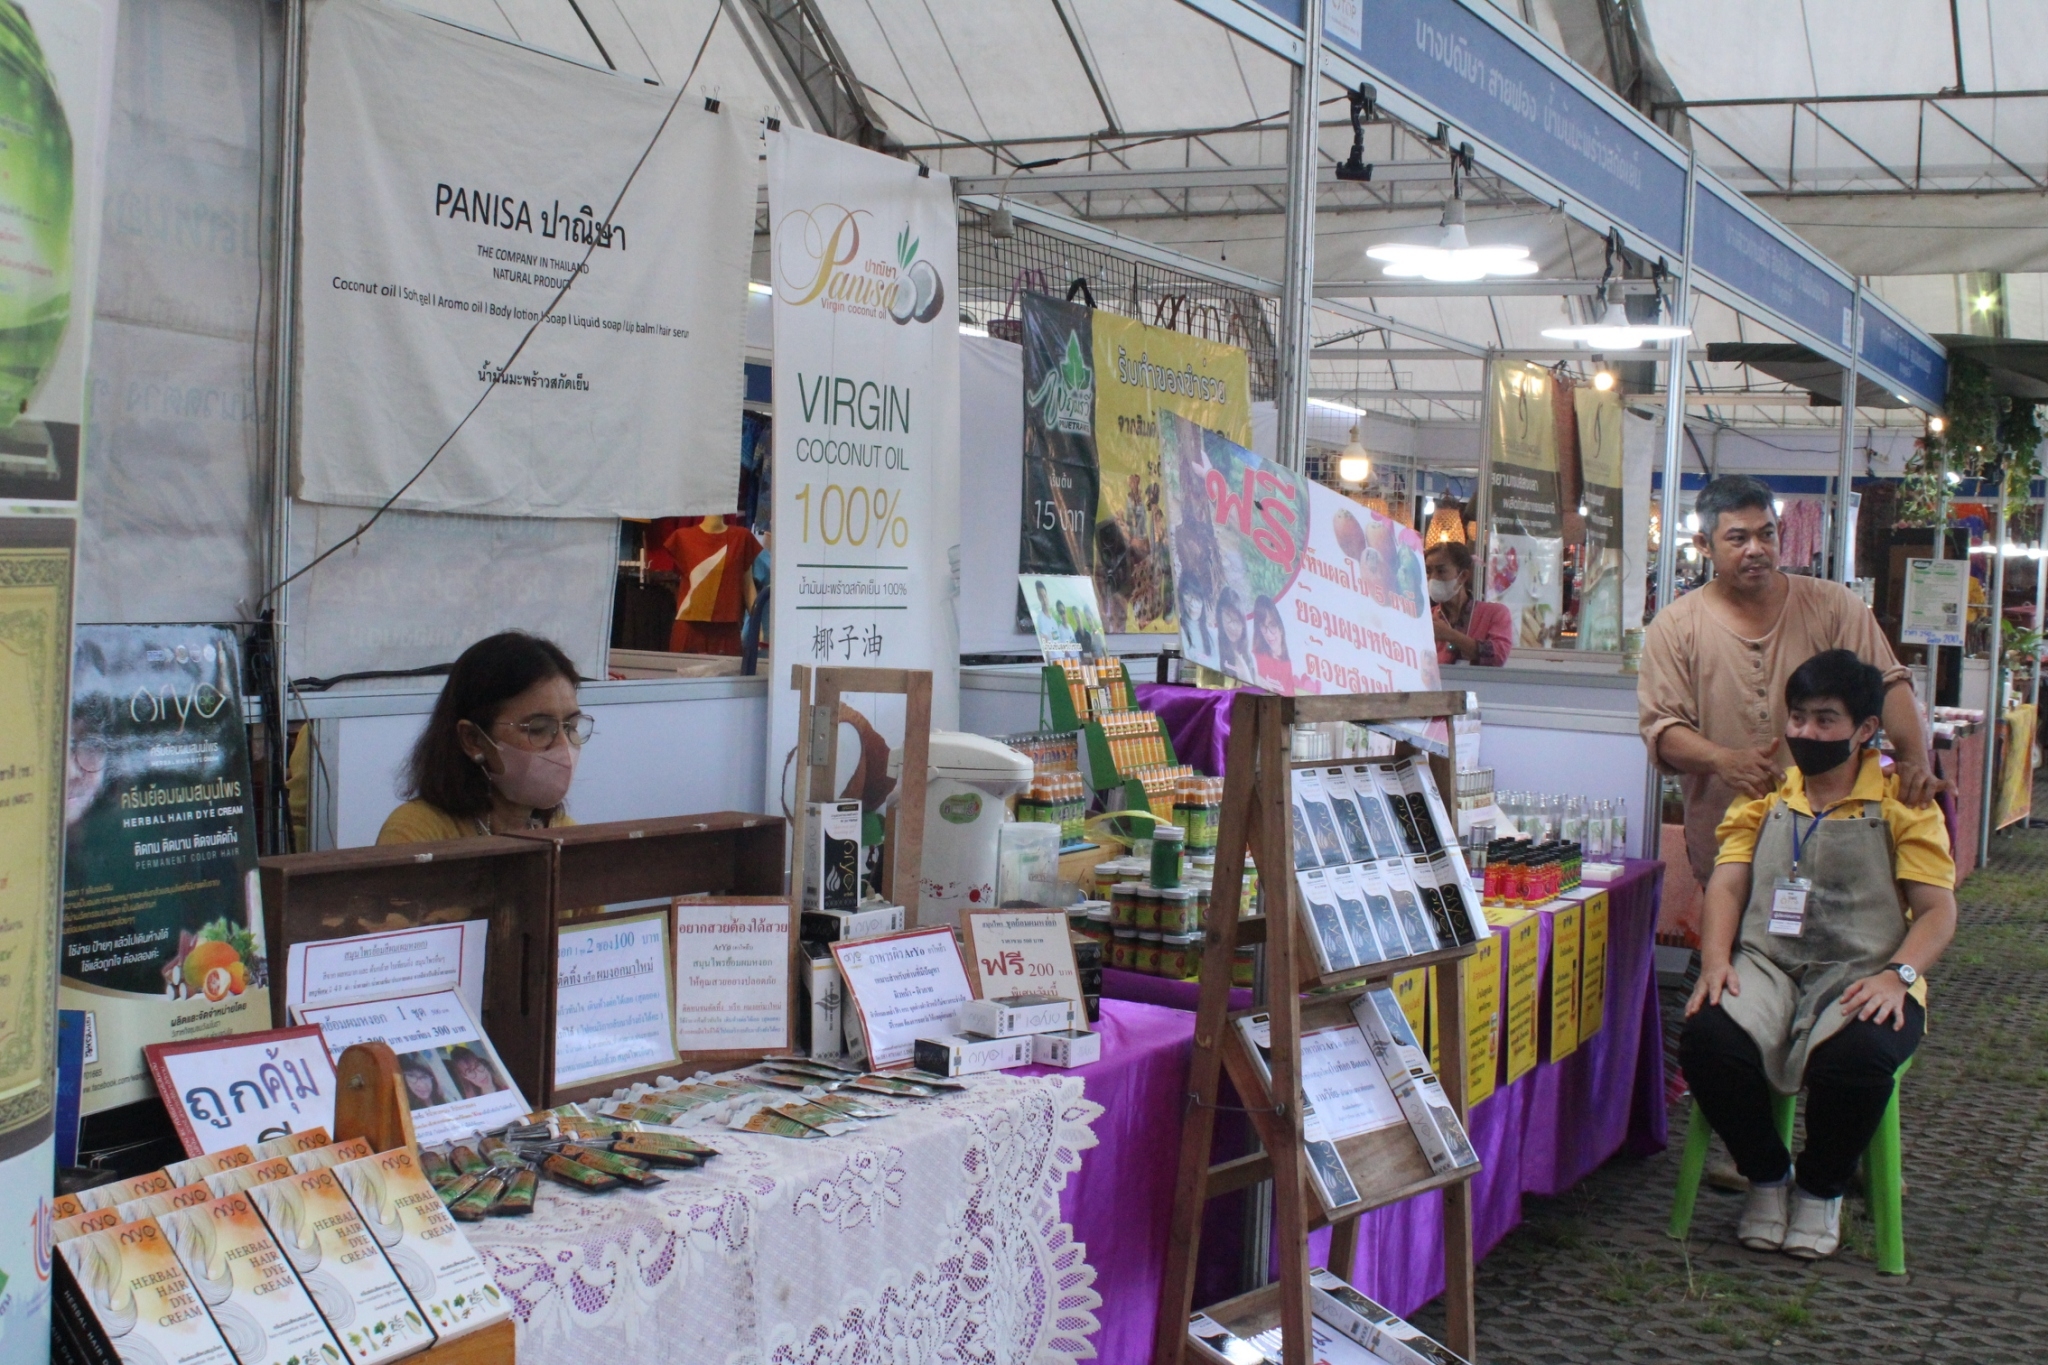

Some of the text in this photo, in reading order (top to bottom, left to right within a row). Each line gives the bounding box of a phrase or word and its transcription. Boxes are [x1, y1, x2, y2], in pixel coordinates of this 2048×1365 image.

[436, 183, 626, 251] PANISA ปาณิษา
[477, 245, 590, 276] THE COMPANY IN THAILAND
[493, 267, 572, 289] NATURAL PRODUCT
[332, 276, 378, 295] Coconut
[381, 285, 396, 297] oil
[472, 300, 484, 314] oil
[489, 304, 512, 320] Body
[513, 307, 539, 321] lotion
[546, 314, 567, 327] Soap
[573, 315, 600, 329] Liquid
[602, 320, 622, 332] soap
[636, 323, 657, 334] balm
[658, 325, 671, 336] hair
[821, 298, 887, 320] Virgin coconut oil
[478, 360, 590, 391] น้ำมันมะพร้าวสกัดเย็น
[1118, 345, 1225, 404] รับทำของชำร่วย
[797, 372, 910, 434] VIRGIN
[796, 437, 910, 471] COCONUT OIL
[795, 483, 909, 549] 100%
[1034, 499, 1055, 530] 15
[1205, 467, 1296, 574] ฟรี
[799, 576, 908, 596] น้ำมันมะพร้าวสกัดเย็น 100%
[811, 623, 883, 662] 椰子油
[121, 777, 241, 809] ครีมย้อมผมสมุนไพร
[123, 805, 243, 828] HERBAL HAIR DYE CREAM
[134, 841, 160, 856] ติดทน
[162, 837, 191, 853] ติดนาน
[135, 847, 240, 870] PERMANENT COLOR HAIR
[68, 943, 91, 957] ใช้ง่าย
[587, 938, 594, 954] 2
[615, 931, 635, 950] 100
[642, 933, 660, 945] บาท
[905, 947, 925, 960] ArYo
[981, 951, 1024, 976] ฟรี
[1028, 963, 1054, 977] 200
[433, 1025, 451, 1038] 300
[394, 1190, 434, 1209] HERBAL
[417, 1202, 442, 1216] HAIR
[314, 1211, 356, 1232] HERBAL
[428, 1212, 449, 1225] DYE
[336, 1222, 364, 1239] HAIR
[349, 1235, 370, 1248] DYE
[421, 1223, 456, 1241] CREAM
[225, 1239, 272, 1261] HERBAL
[249, 1252, 280, 1268] HAIR
[340, 1246, 378, 1265] CREAM
[131, 1267, 181, 1290] HERBAL
[263, 1263, 287, 1278] DYE
[157, 1281, 189, 1298] HAIR
[253, 1276, 294, 1296] CREAM
[64, 1289, 87, 1329] HERBAL
[169, 1294, 196, 1309] DYE
[159, 1306, 203, 1328] CREAM
